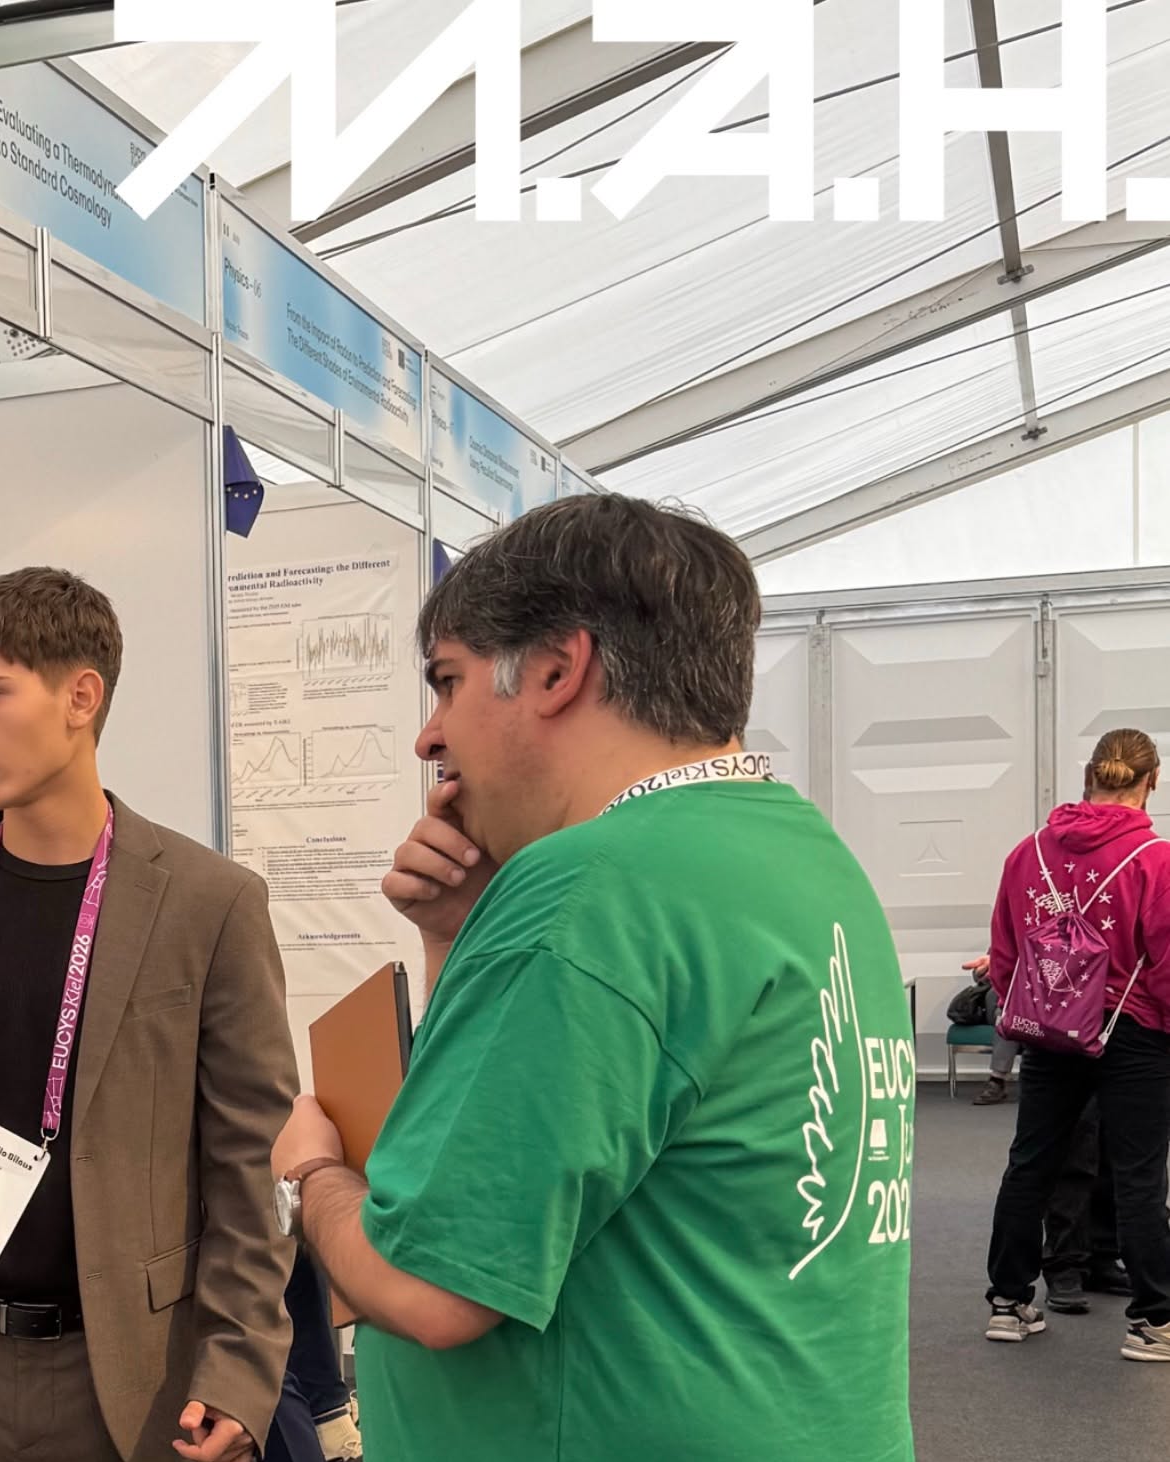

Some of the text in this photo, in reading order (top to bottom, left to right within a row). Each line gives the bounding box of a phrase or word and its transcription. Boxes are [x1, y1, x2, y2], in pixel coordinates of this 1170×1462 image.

[10, 141, 58, 192] Standard
[60, 175, 112, 230] Cosmology
[227, 571, 263, 582] rediction
[228, 578, 267, 591] onmental
[665, 762, 710, 789] Kiel
[52, 934, 91, 1070] EUCYS Kiel 2026
[864, 1037, 915, 1099] EUC
[867, 1178, 911, 1243] 202
